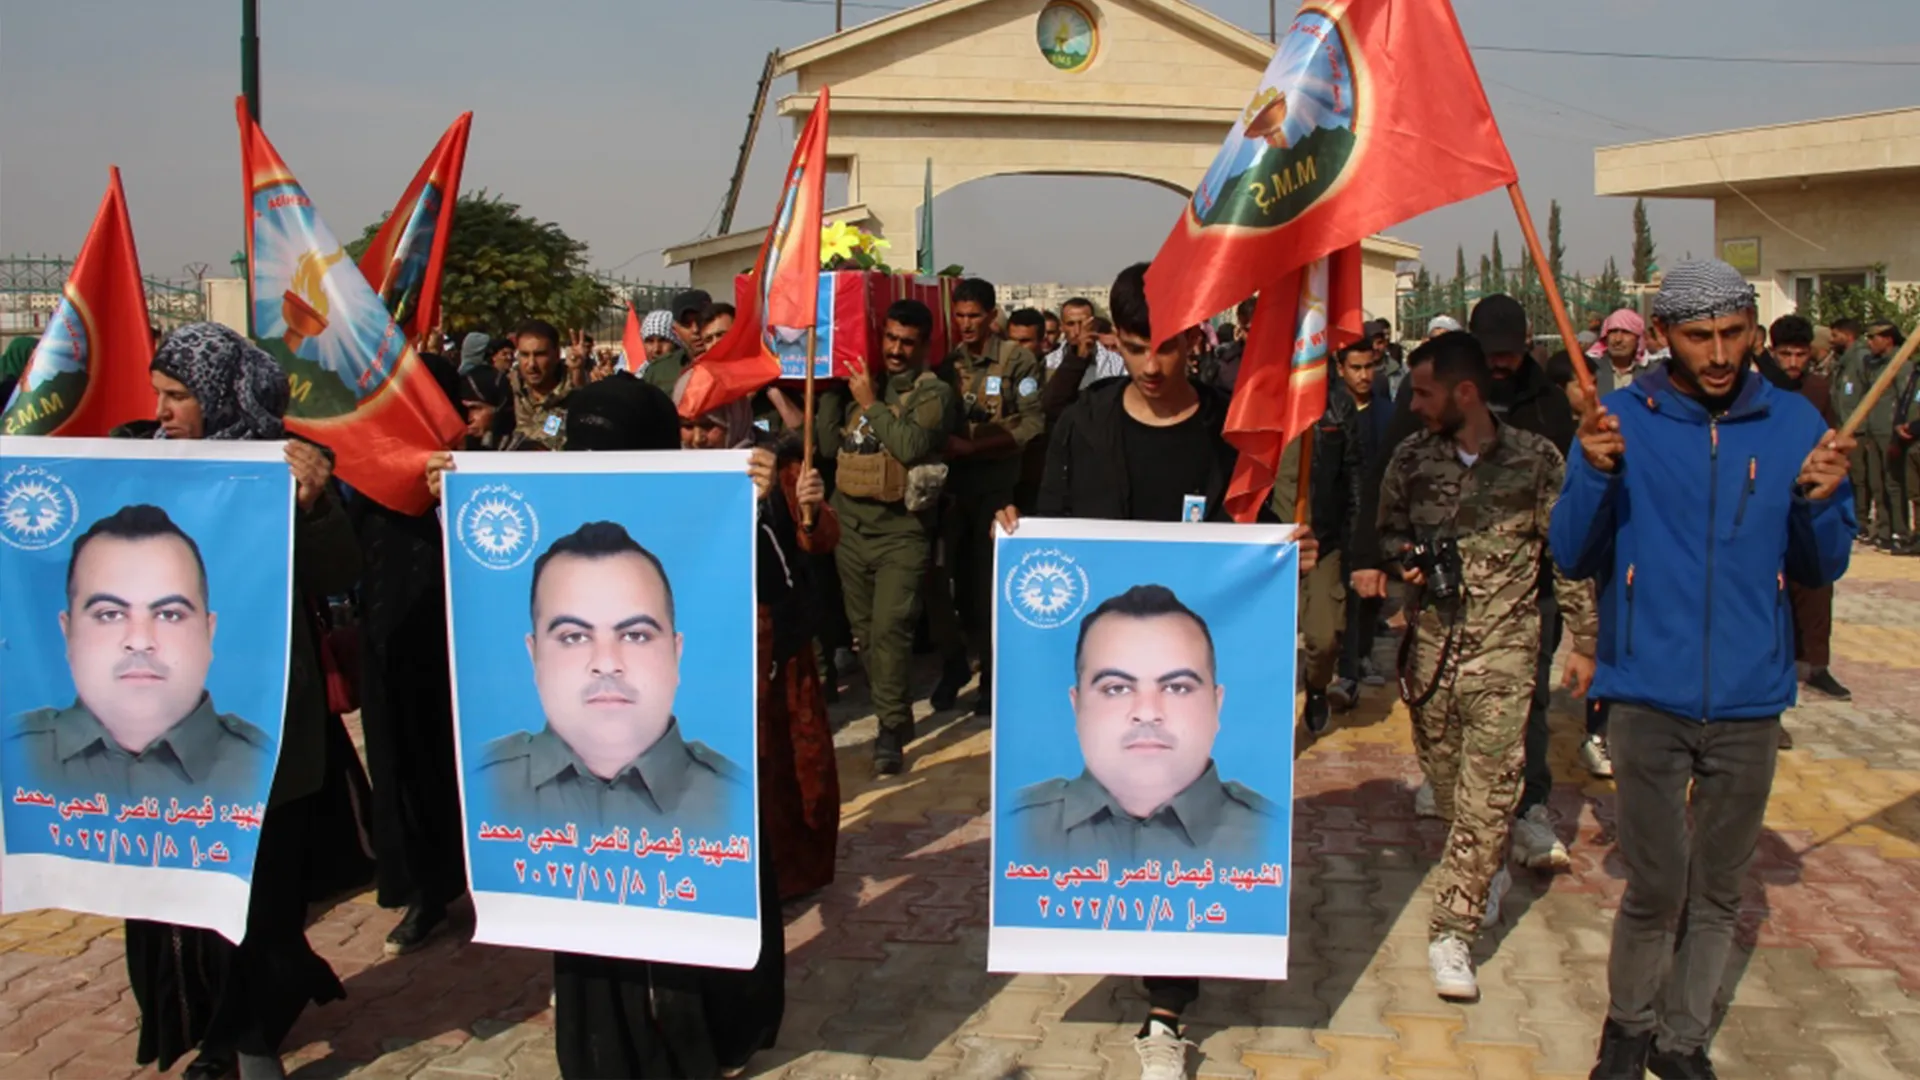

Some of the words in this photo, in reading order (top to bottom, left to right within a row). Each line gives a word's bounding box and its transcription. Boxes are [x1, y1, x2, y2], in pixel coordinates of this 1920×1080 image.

[13, 786, 55, 808] محمد
[59, 793, 108, 821] الحجي
[115, 797, 159, 822] ناصر
[164, 795, 214, 828] فيصل
[478, 821, 524, 841] محمد
[528, 822, 578, 854] الحجي
[584, 826, 630, 855] ناصر
[634, 827, 683, 861] فيصل
[688, 834, 750, 866] الشهيد:
[1005, 862, 1049, 880] محمد
[1053, 859, 1109, 891] الحجي
[1114, 859, 1161, 888] ناصر
[1165, 858, 1214, 889] فيصل
[1220, 863, 1282, 891] الشهيد:
